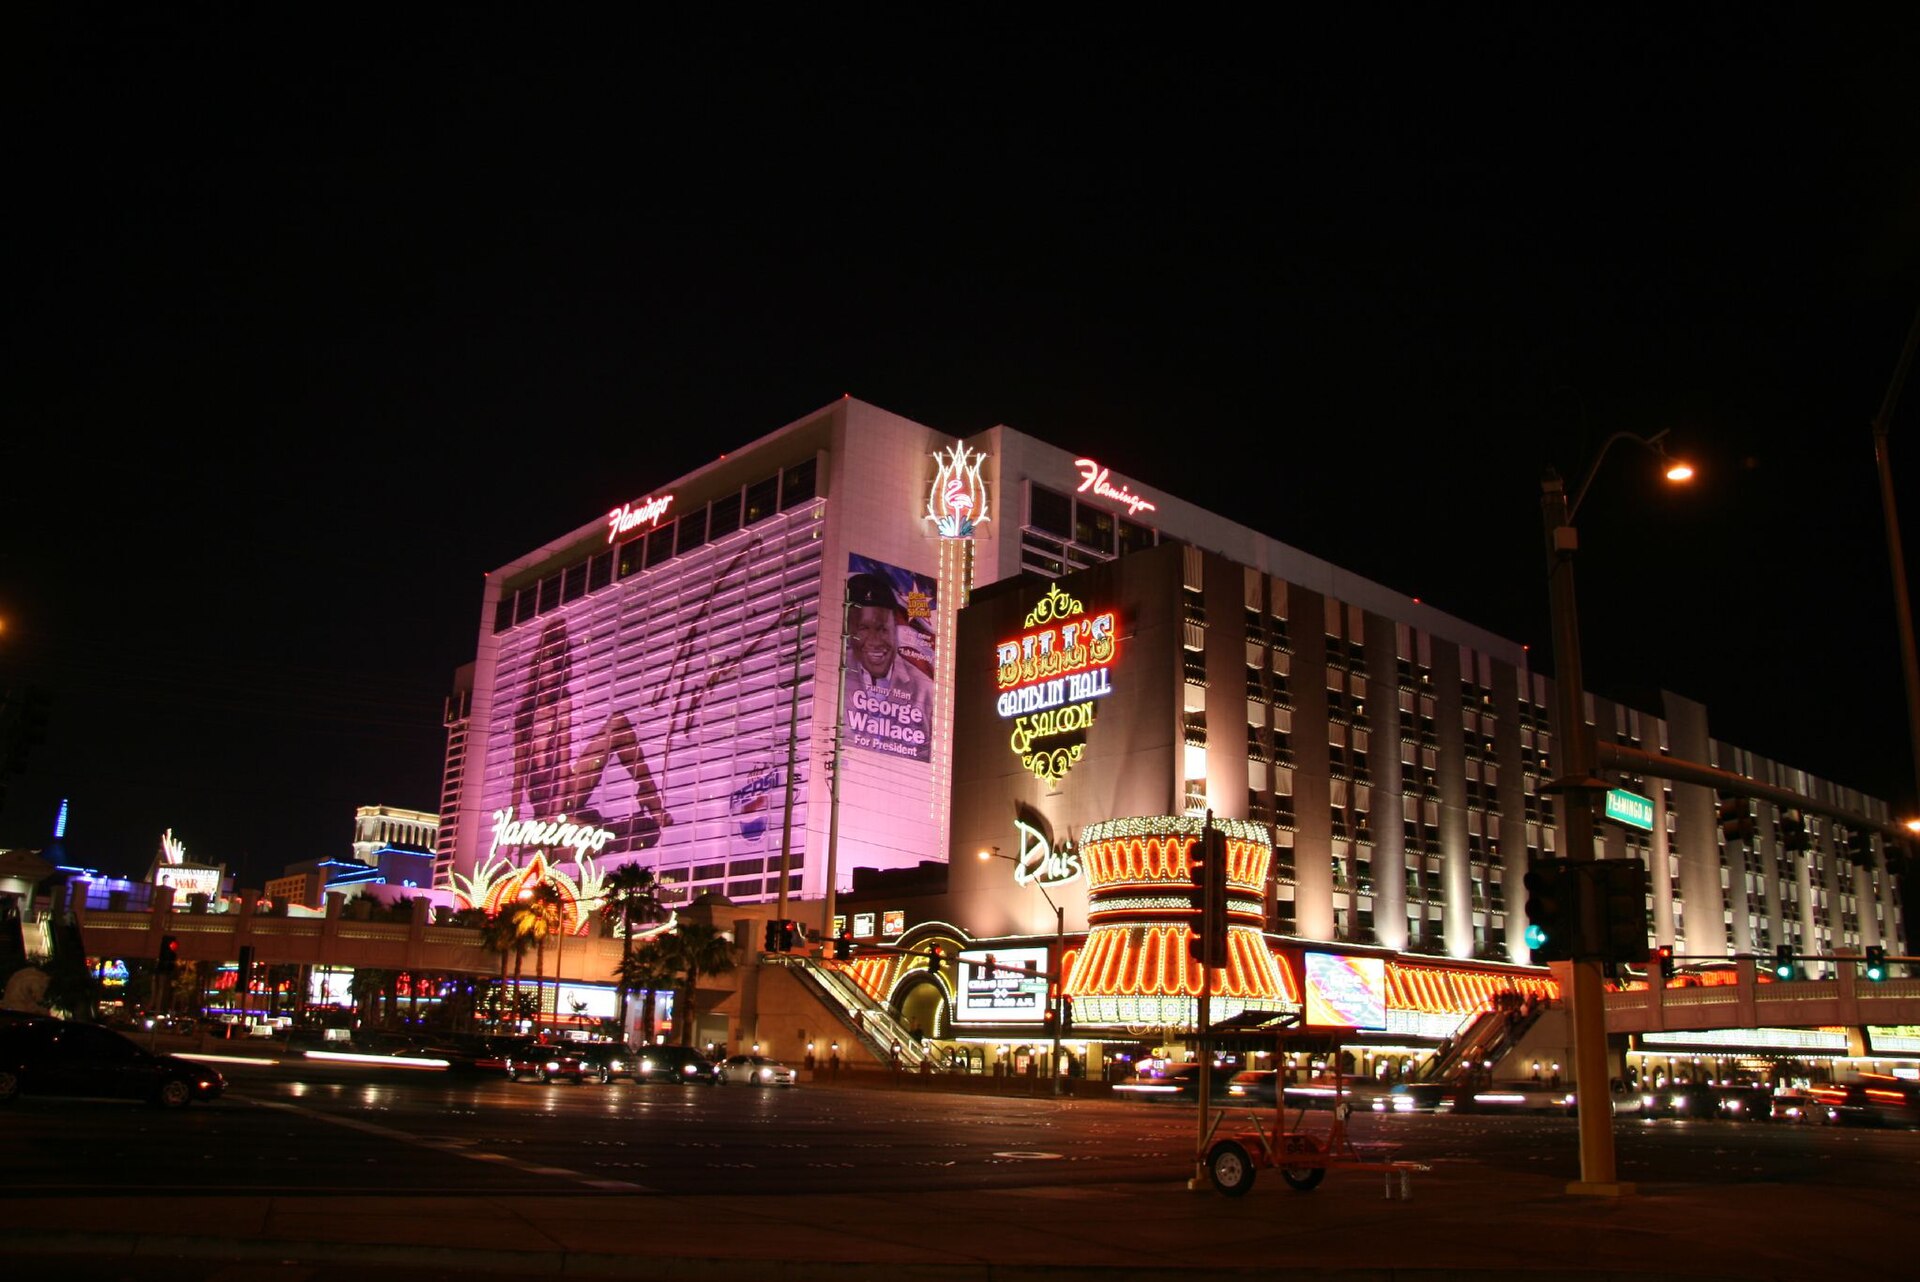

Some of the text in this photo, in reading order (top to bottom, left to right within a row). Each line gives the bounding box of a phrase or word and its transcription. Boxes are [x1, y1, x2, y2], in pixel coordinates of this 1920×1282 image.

[1075, 459, 1156, 516] Flamingo
[608, 495, 674, 544] Flamingo
[997, 613, 1115, 688] BILL'S
[865, 683, 911, 700] Funny Man
[1070, 668, 1112, 702] HALL
[853, 690, 923, 724] George
[1030, 701, 1094, 738] SALOON
[848, 710, 925, 744] Wallace
[854, 734, 918, 757] For President
[1608, 793, 1653, 822] FLAMINGO RD
[490, 806, 616, 862] Flamingo
[174, 878, 198, 889] WAR
